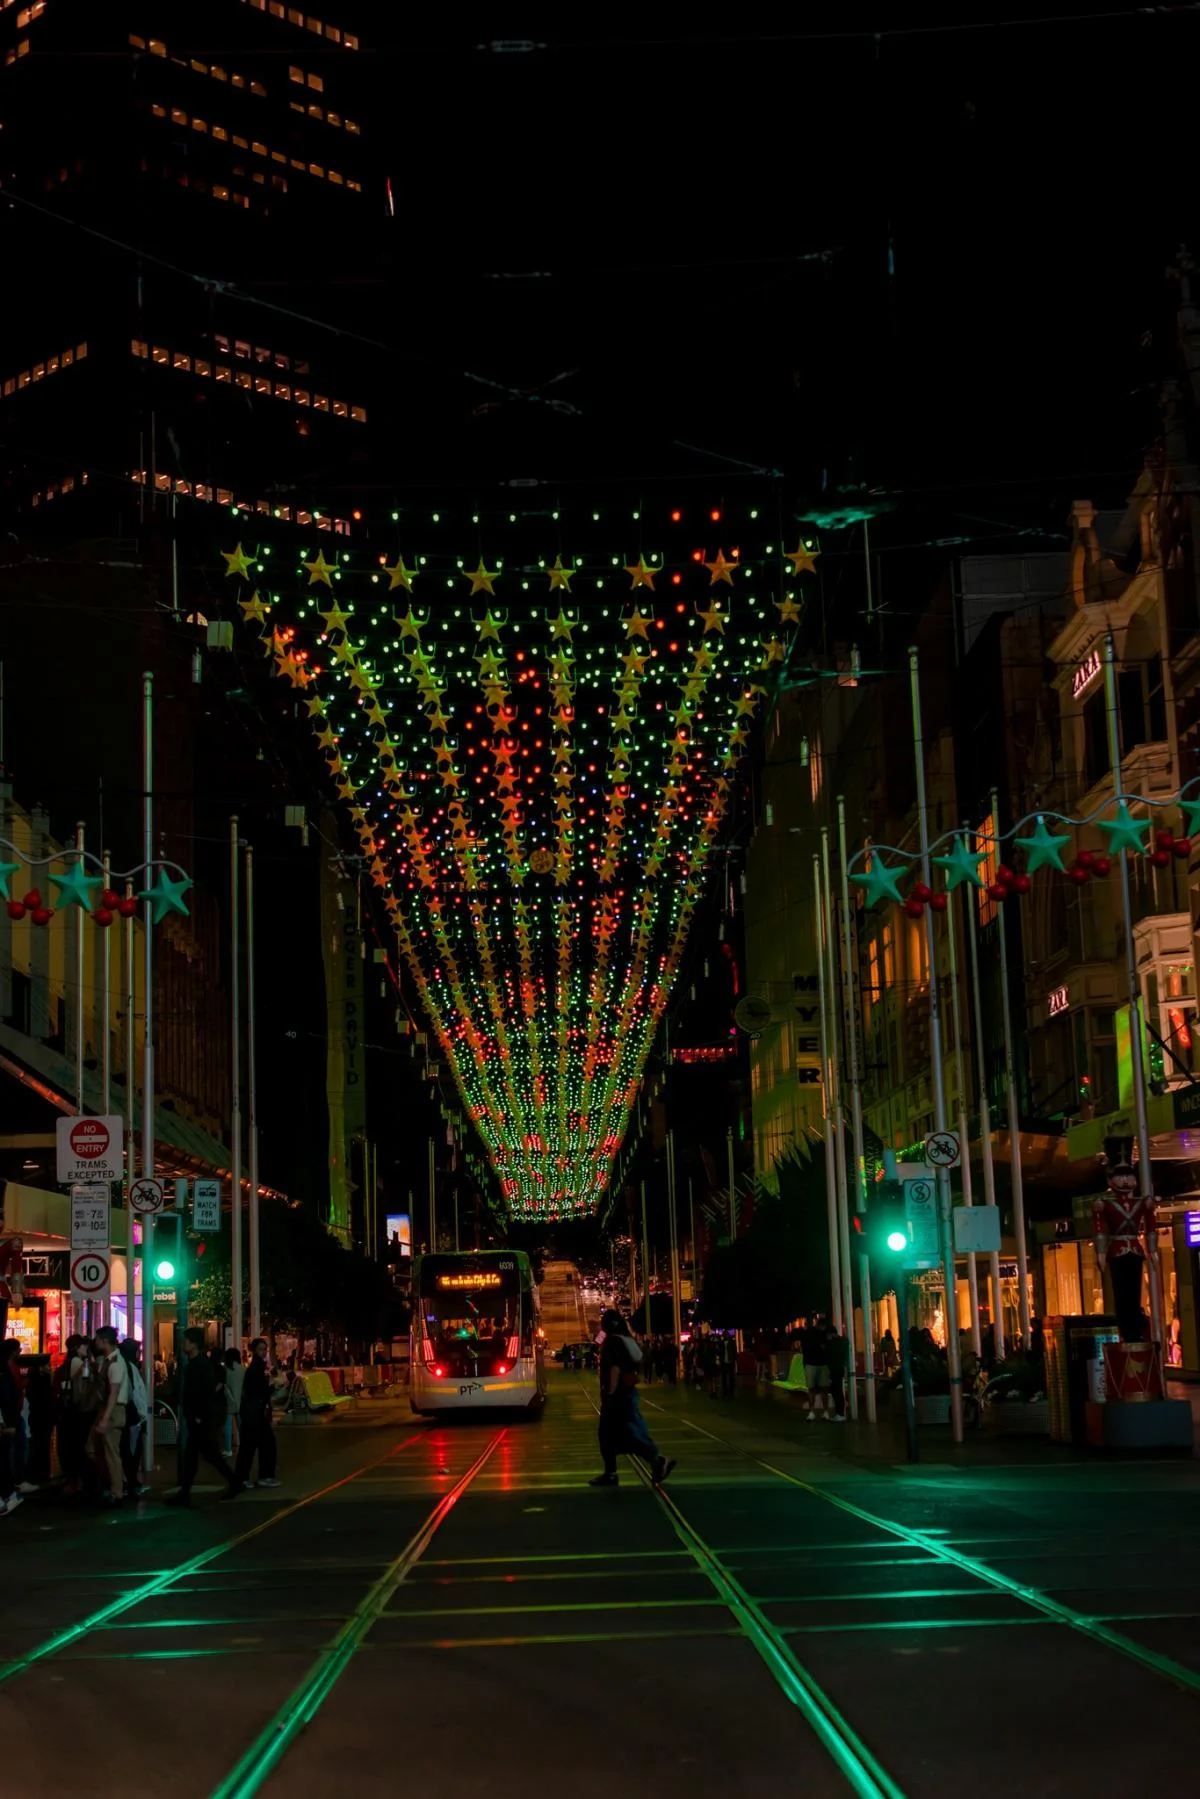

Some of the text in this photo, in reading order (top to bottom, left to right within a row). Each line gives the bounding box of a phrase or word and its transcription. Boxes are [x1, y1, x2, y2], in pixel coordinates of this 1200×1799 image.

[1072, 650, 1101, 696] ZARA
[344, 907, 358, 1085] ROGER DAVID
[794, 975, 820, 1084] MYER
[83, 1125, 96, 1134] NO
[76, 1144, 105, 1153] ENTRY
[75, 1160, 108, 1169] TRAMS
[67, 1170, 115, 1180] EXCEPTED
[201, 1210, 213, 1218] FOR
[81, 1264, 100, 1282] 10
[152, 1291, 176, 1301] rebel
